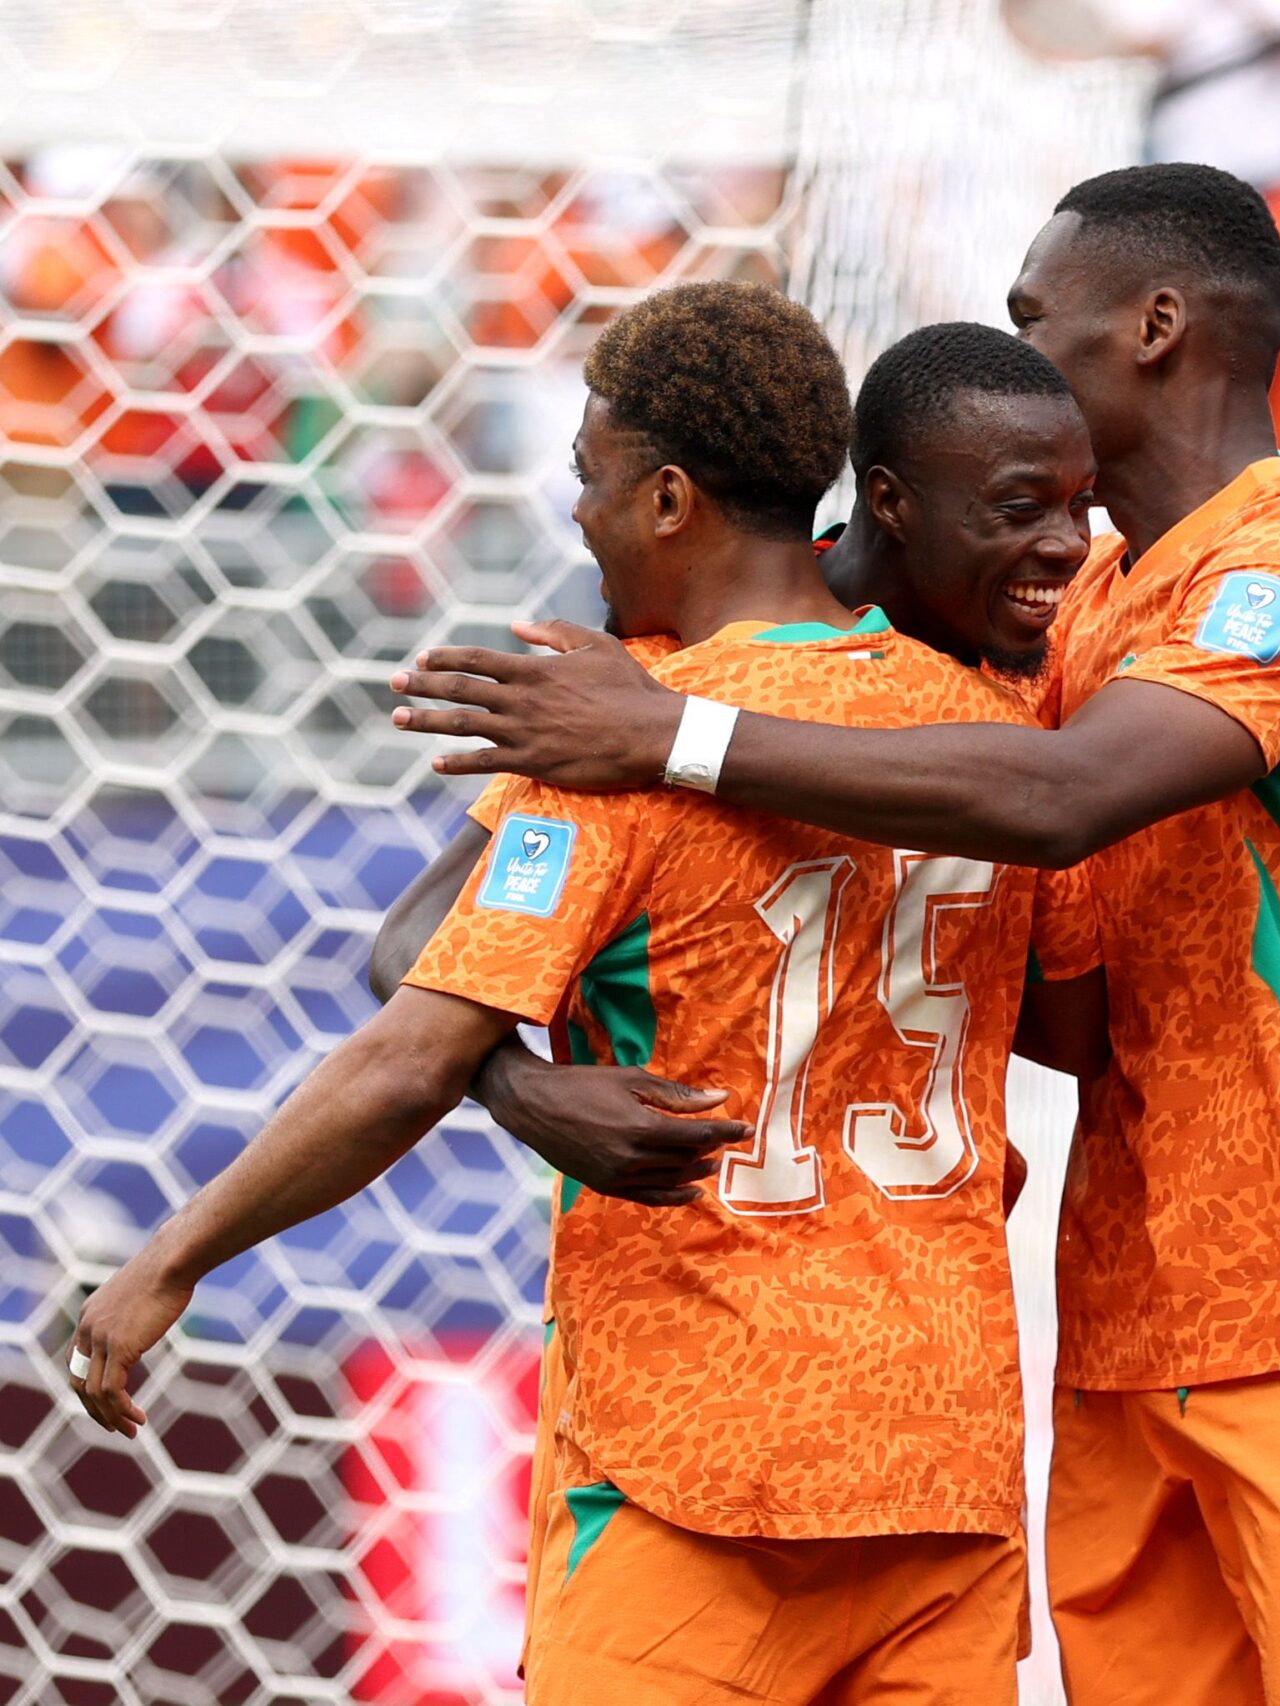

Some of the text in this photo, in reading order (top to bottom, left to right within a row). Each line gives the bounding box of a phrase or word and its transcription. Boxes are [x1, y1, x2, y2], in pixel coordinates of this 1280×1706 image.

[1223, 618, 1266, 646] PEACE
[503, 875, 542, 894] PEACE
[718, 848, 1007, 1216] 15
